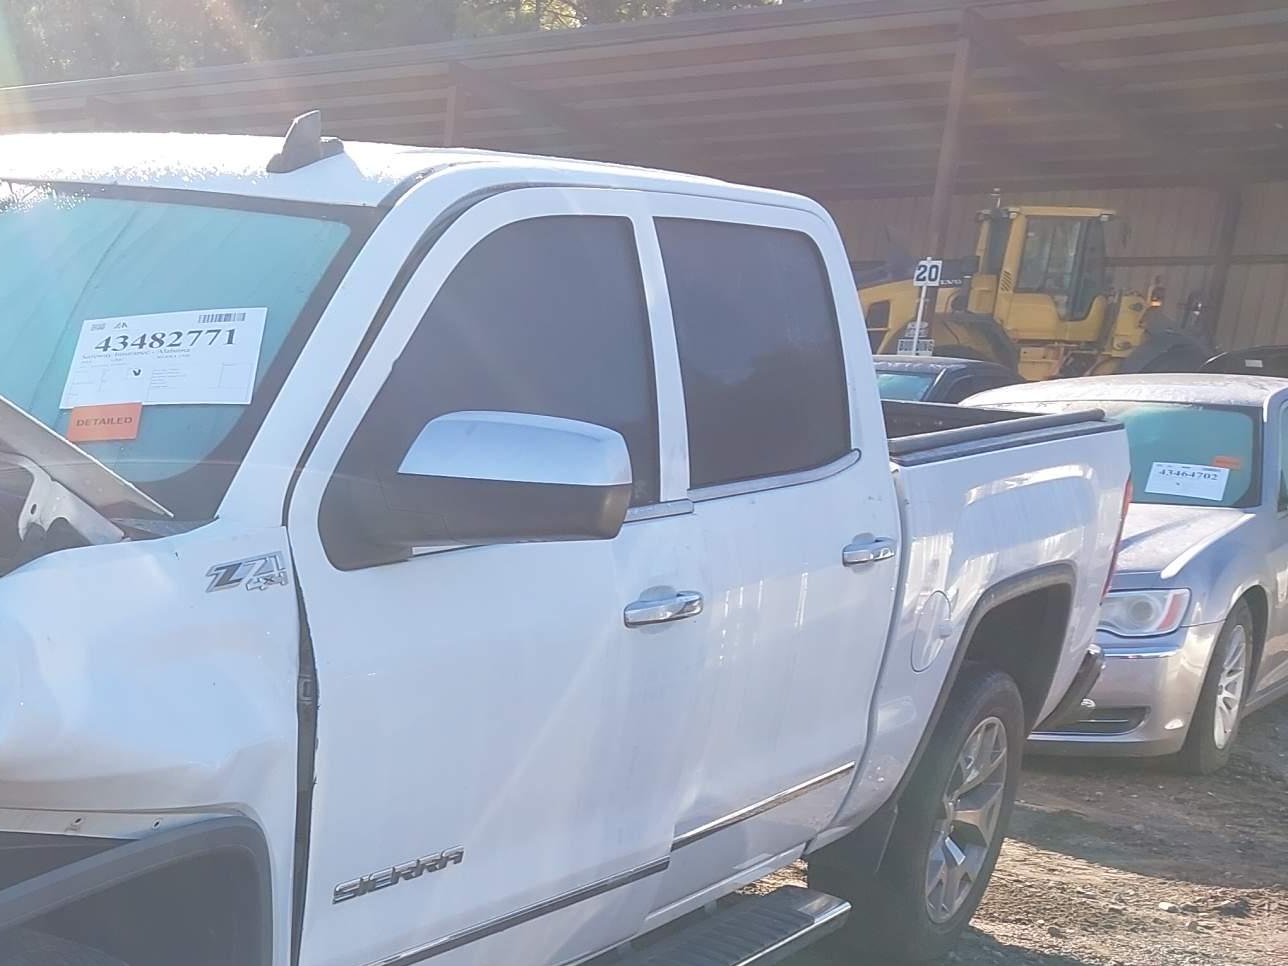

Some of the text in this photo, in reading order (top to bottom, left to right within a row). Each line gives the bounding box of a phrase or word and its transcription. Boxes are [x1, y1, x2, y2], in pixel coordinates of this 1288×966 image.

[916, 264, 939, 282] 20
[94, 329, 235, 351] 43482771
[75, 416, 133, 427] DETAILED
[1158, 469, 1220, 481] 43464702
[205, 552, 283, 593] Z71
[332, 845, 464, 905] SIERRA
